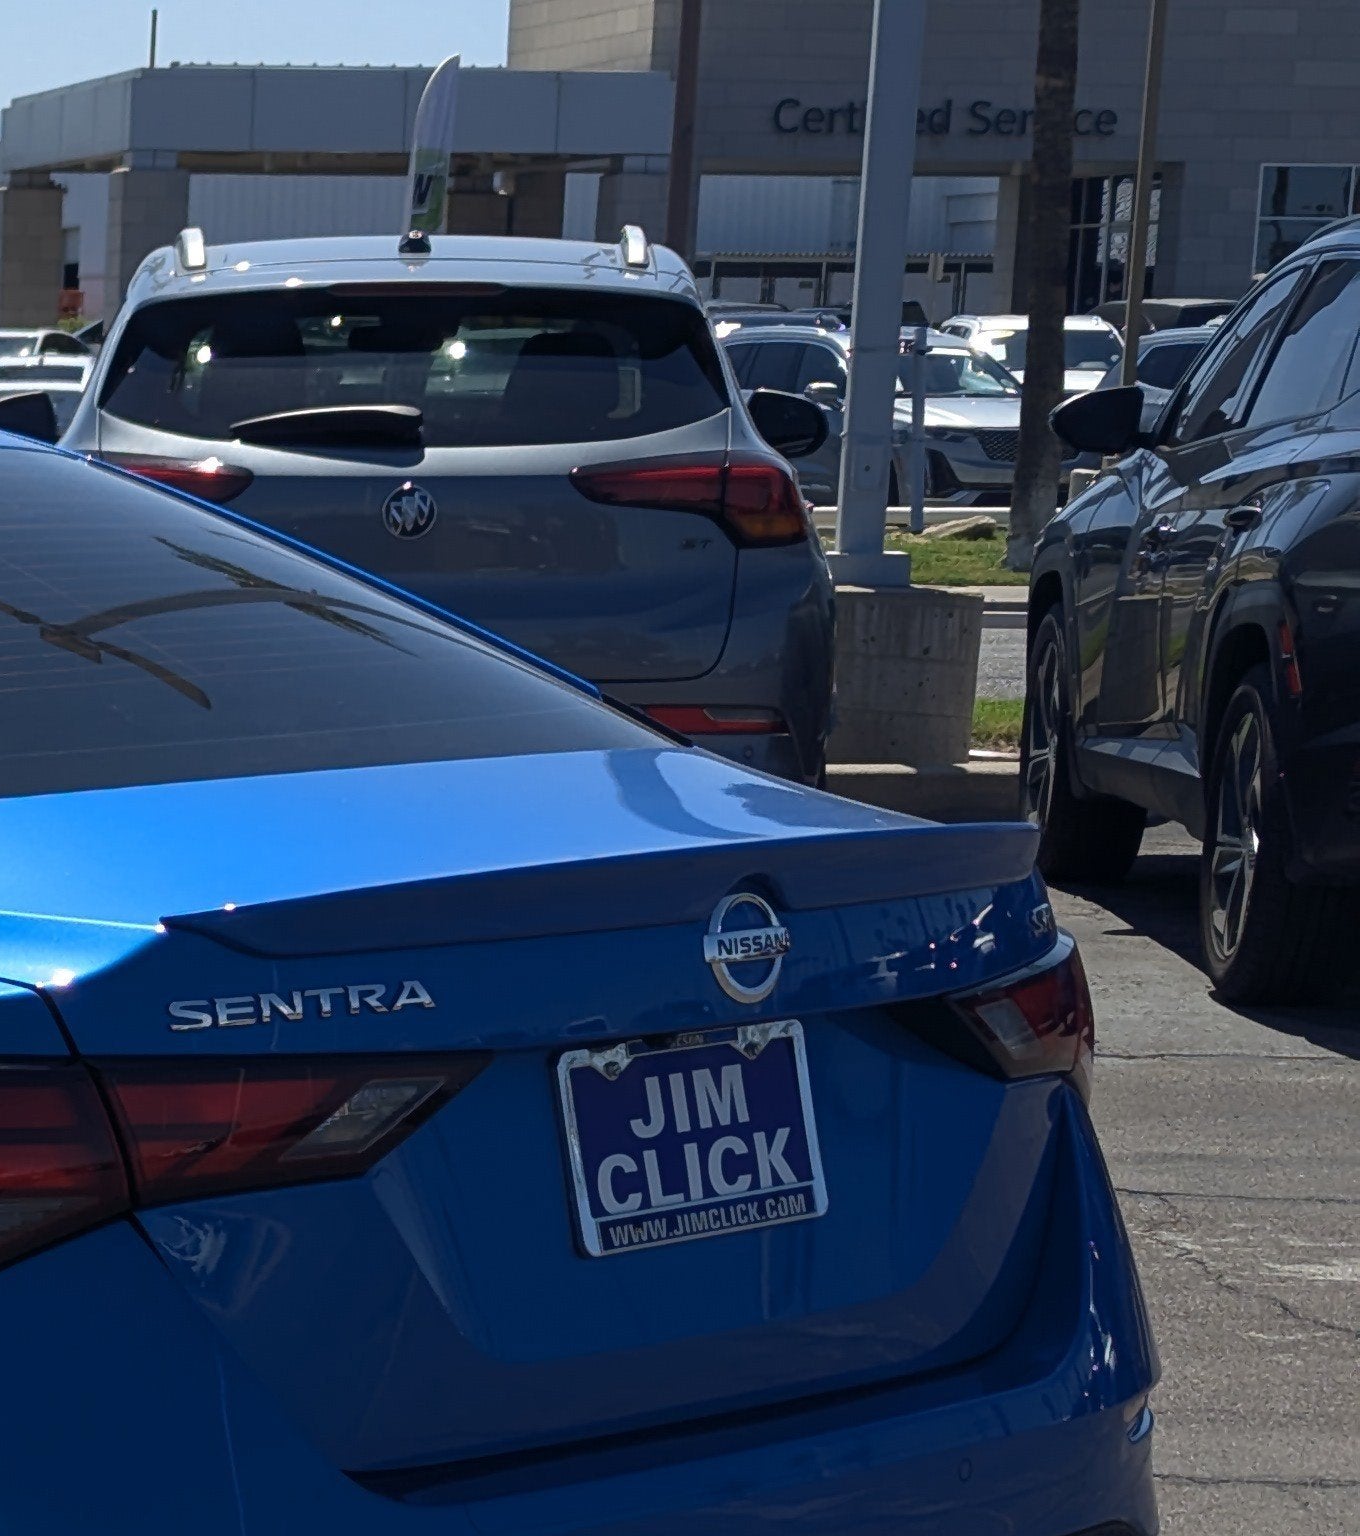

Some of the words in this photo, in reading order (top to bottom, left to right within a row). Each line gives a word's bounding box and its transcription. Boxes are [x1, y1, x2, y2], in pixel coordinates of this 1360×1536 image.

[773, 97, 952, 136] Certd
[968, 100, 1118, 138] Serce
[717, 932, 787, 956] NISSAN
[168, 980, 436, 1031] SENTRA
[630, 1063, 750, 1139] JIM
[597, 1126, 798, 1215] CLICK
[609, 1193, 807, 1248] WWW.JIMCLICK.COM
